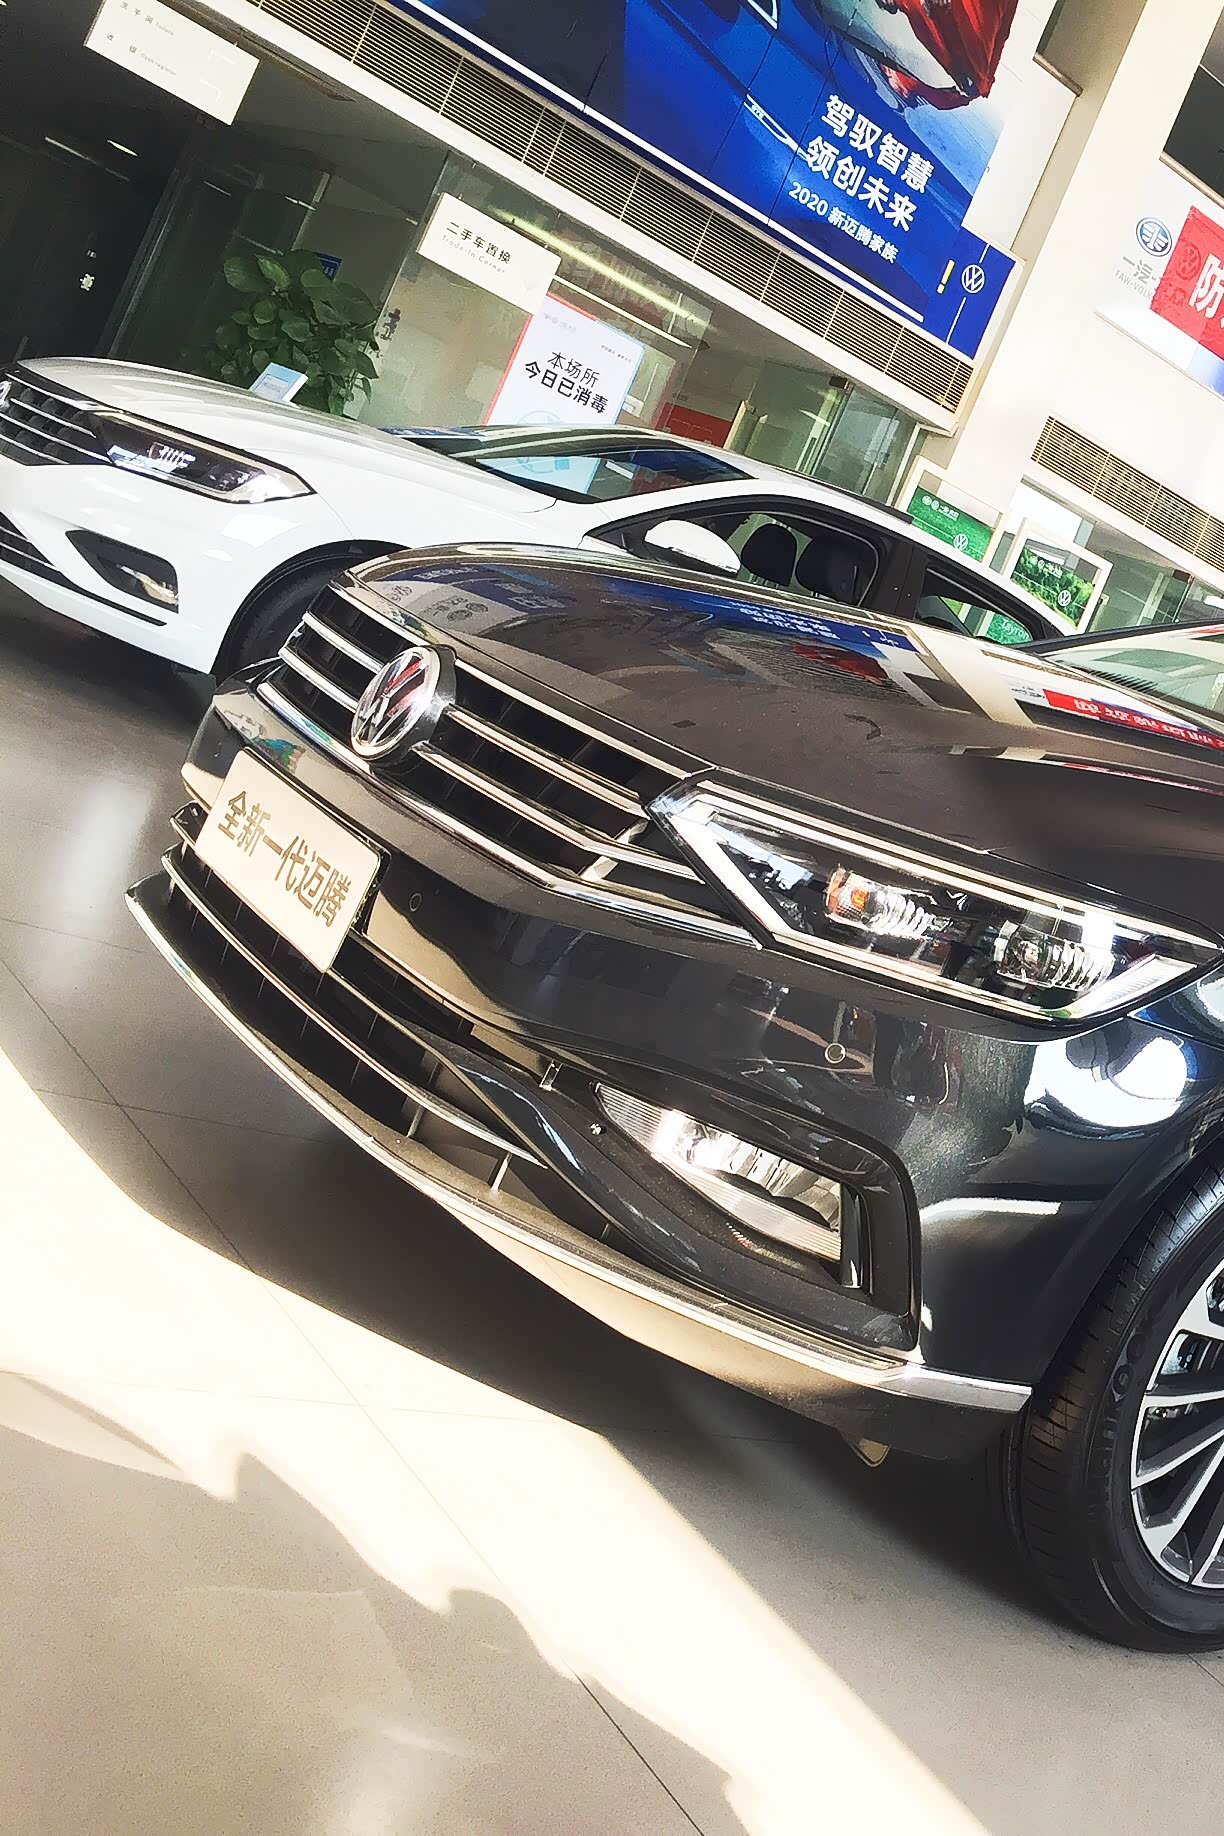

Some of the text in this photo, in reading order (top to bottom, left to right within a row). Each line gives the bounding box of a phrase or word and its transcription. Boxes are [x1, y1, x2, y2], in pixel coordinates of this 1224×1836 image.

[821, 94, 935, 194] 驾驭智慧
[807, 135, 917, 232] 领创未来
[446, 221, 511, 264] 二手车置换
[788, 181, 900, 264] 2020 新迈腾家族
[524, 360, 609, 414] 今日已消毒
[546, 351, 601, 388] 本场所
[1001, 617, 1030, 640] Tayron
[217, 790, 352, 927] 全新一代迈腾
